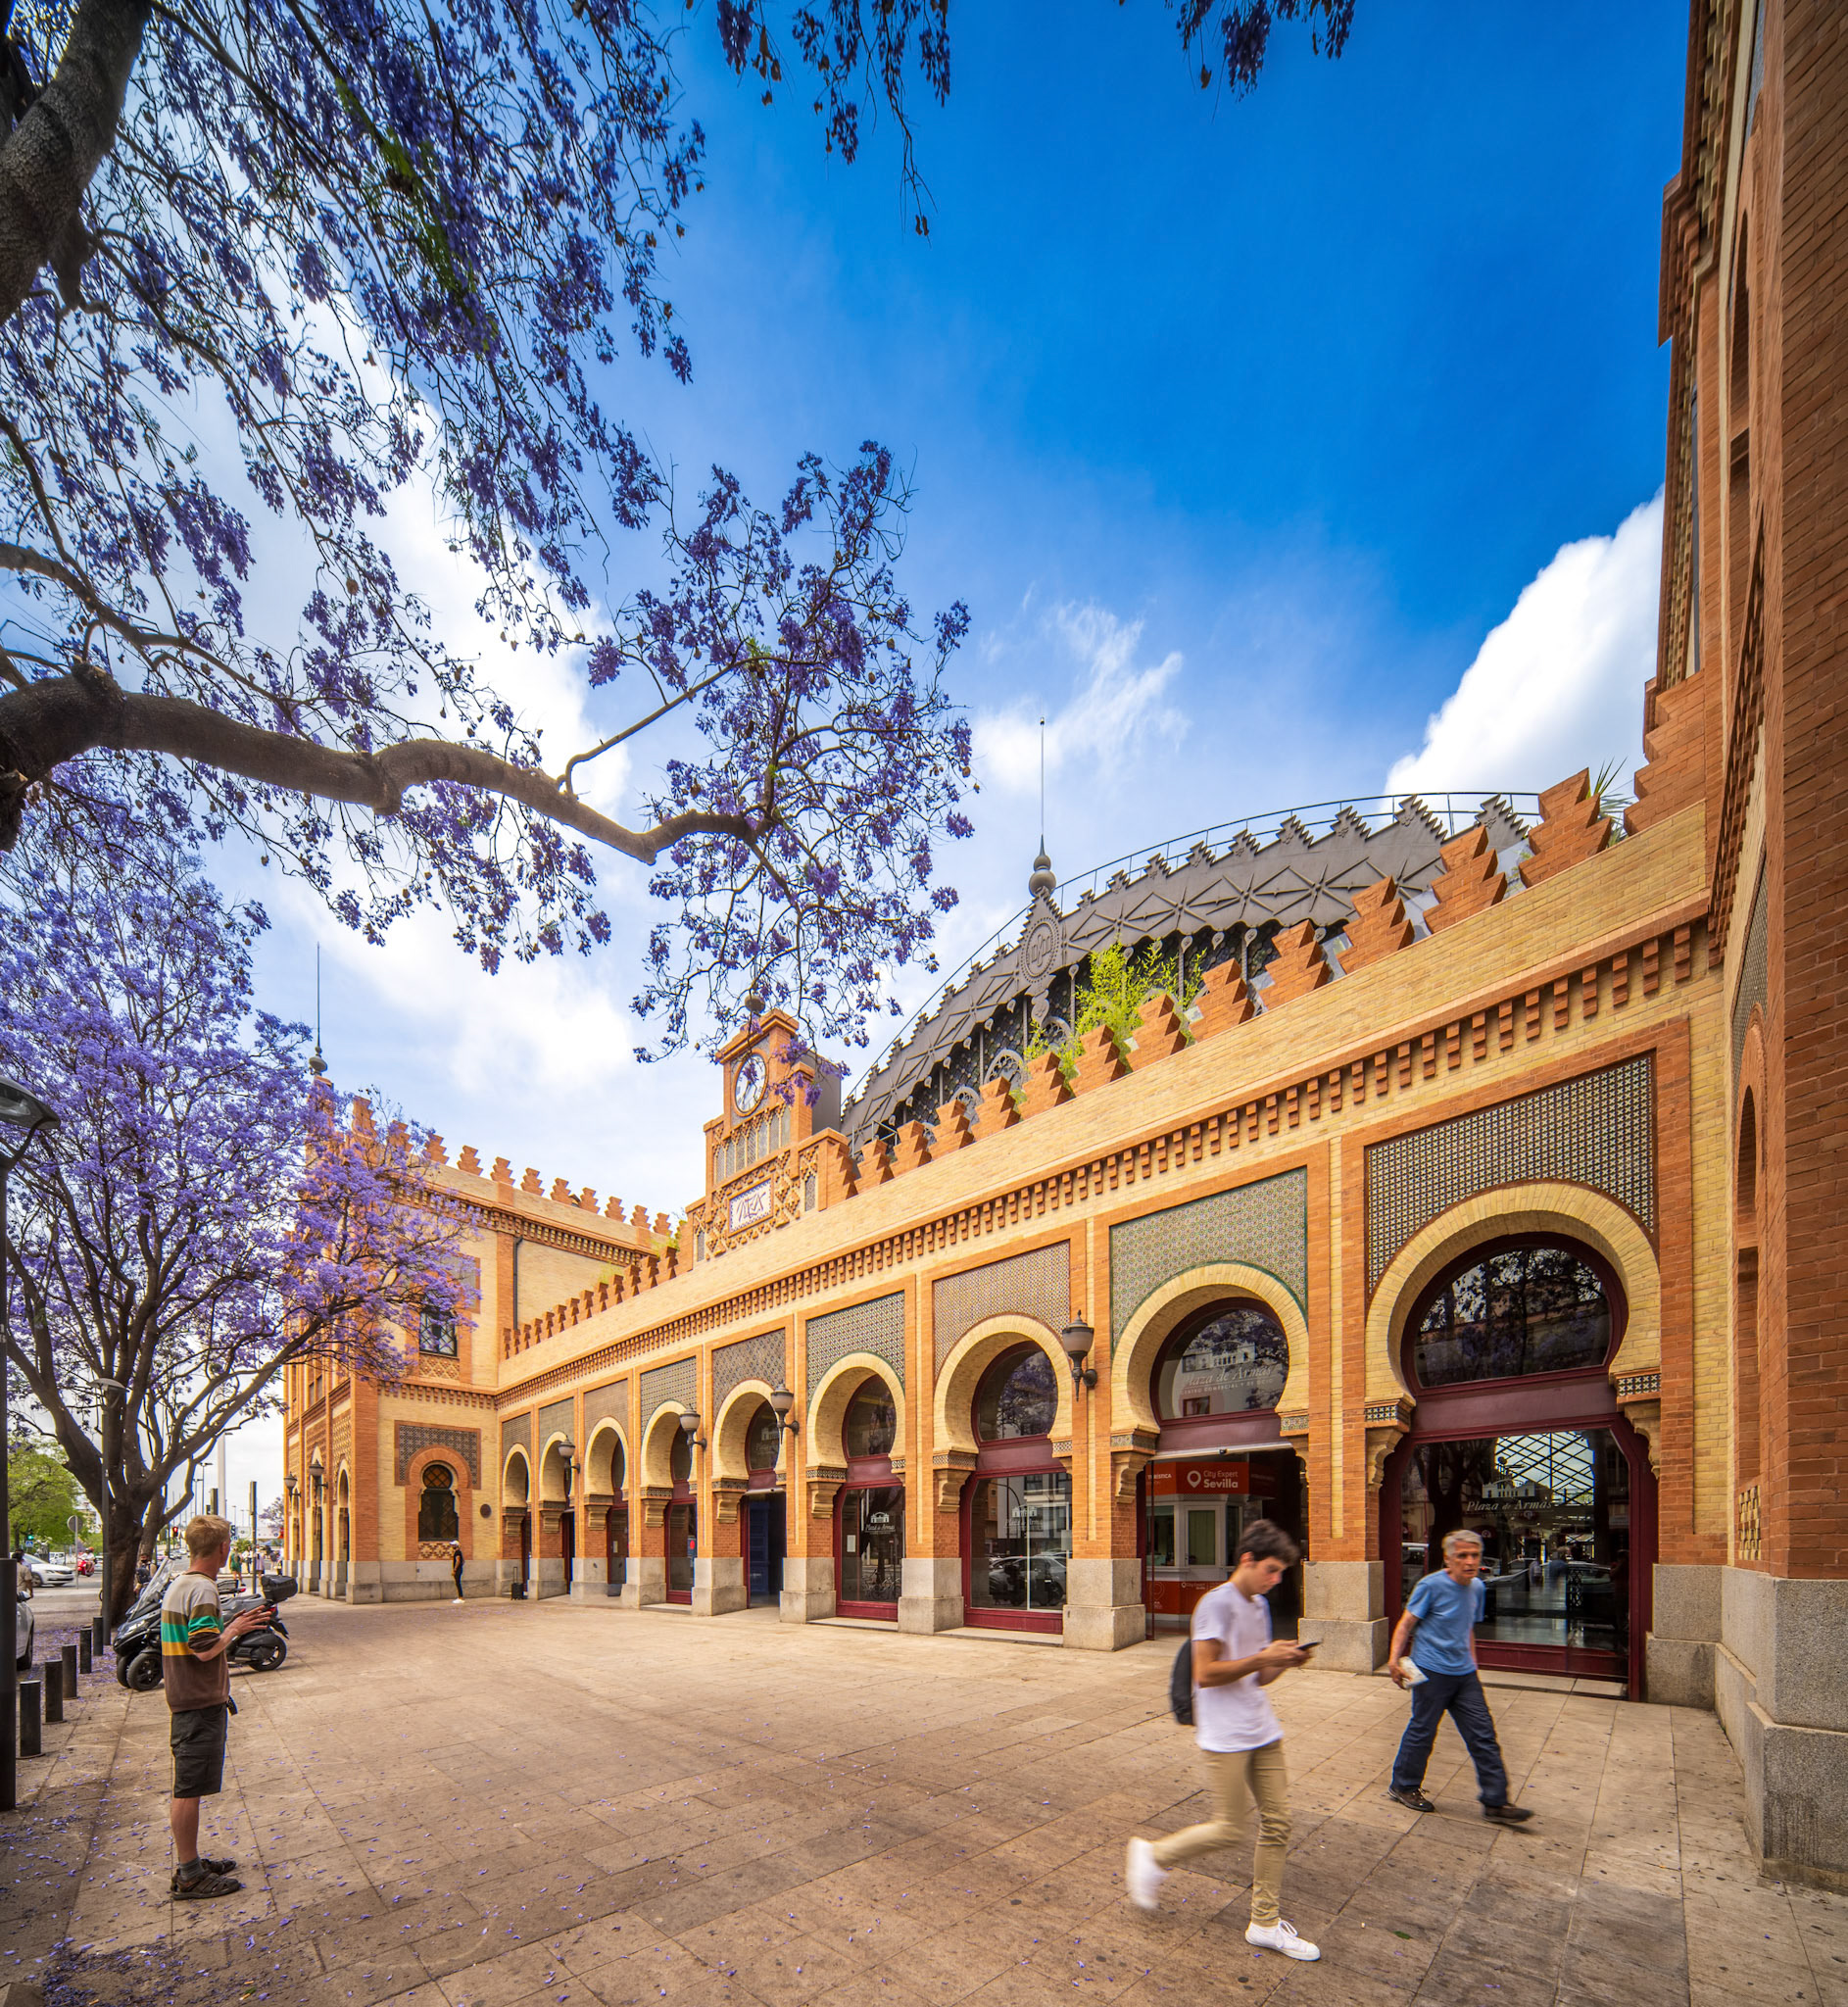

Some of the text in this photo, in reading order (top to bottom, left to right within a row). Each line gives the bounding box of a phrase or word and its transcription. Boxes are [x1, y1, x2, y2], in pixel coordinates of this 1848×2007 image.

[1217, 1368, 1230, 1381] de
[1203, 1470, 1238, 1479] City Expert
[1203, 1479, 1239, 1489] Sevilla
[1467, 1500, 1499, 1511] Plaza
[1514, 1499, 1552, 1510] Armas
